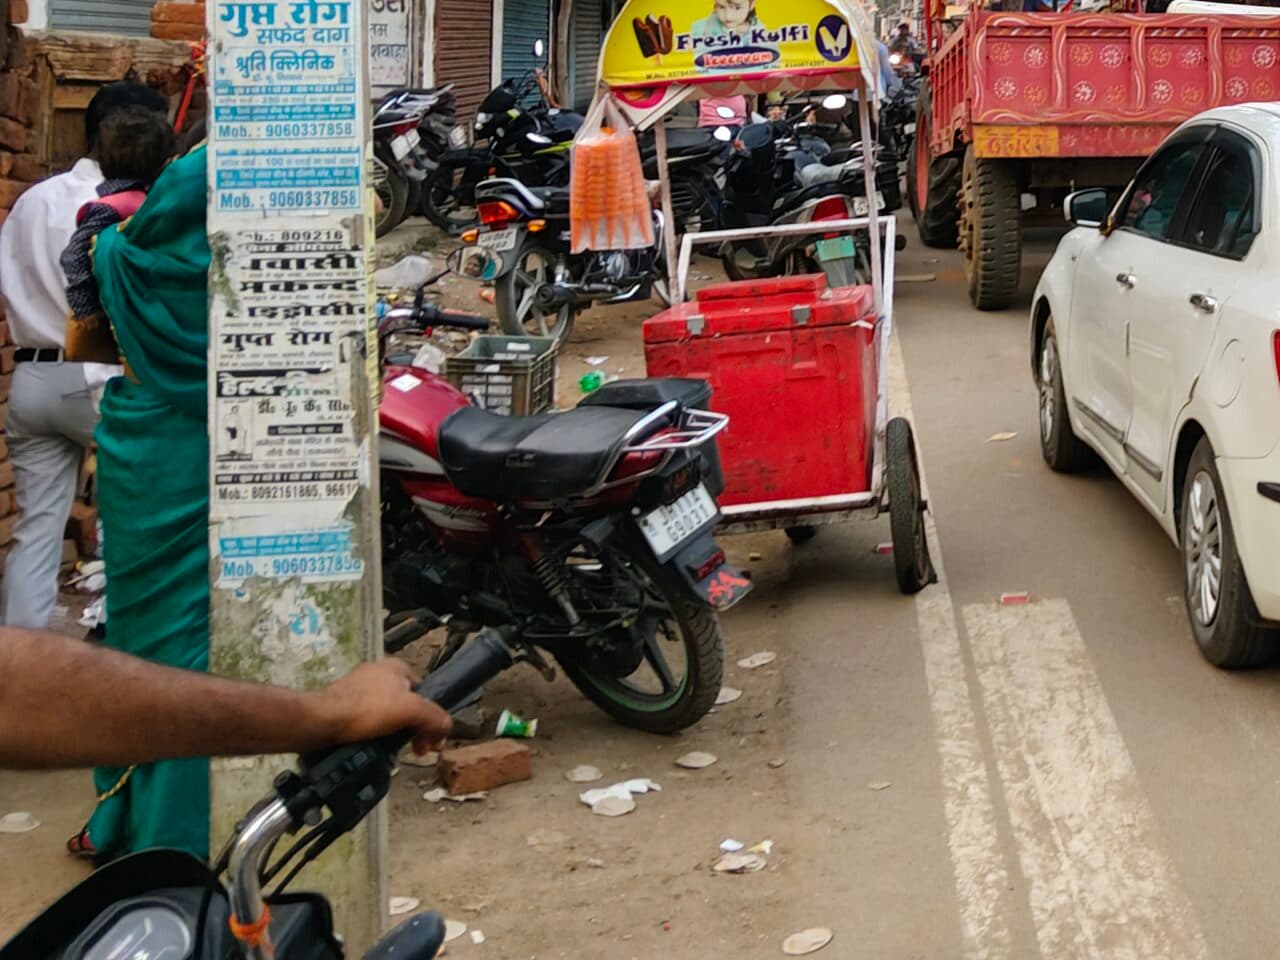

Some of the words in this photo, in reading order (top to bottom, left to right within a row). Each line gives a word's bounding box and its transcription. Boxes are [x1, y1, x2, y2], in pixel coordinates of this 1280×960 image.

[312, 27, 351, 44] दाग
[676, 31, 741, 50] Fresh
[752, 25, 809, 44] Kulfi
